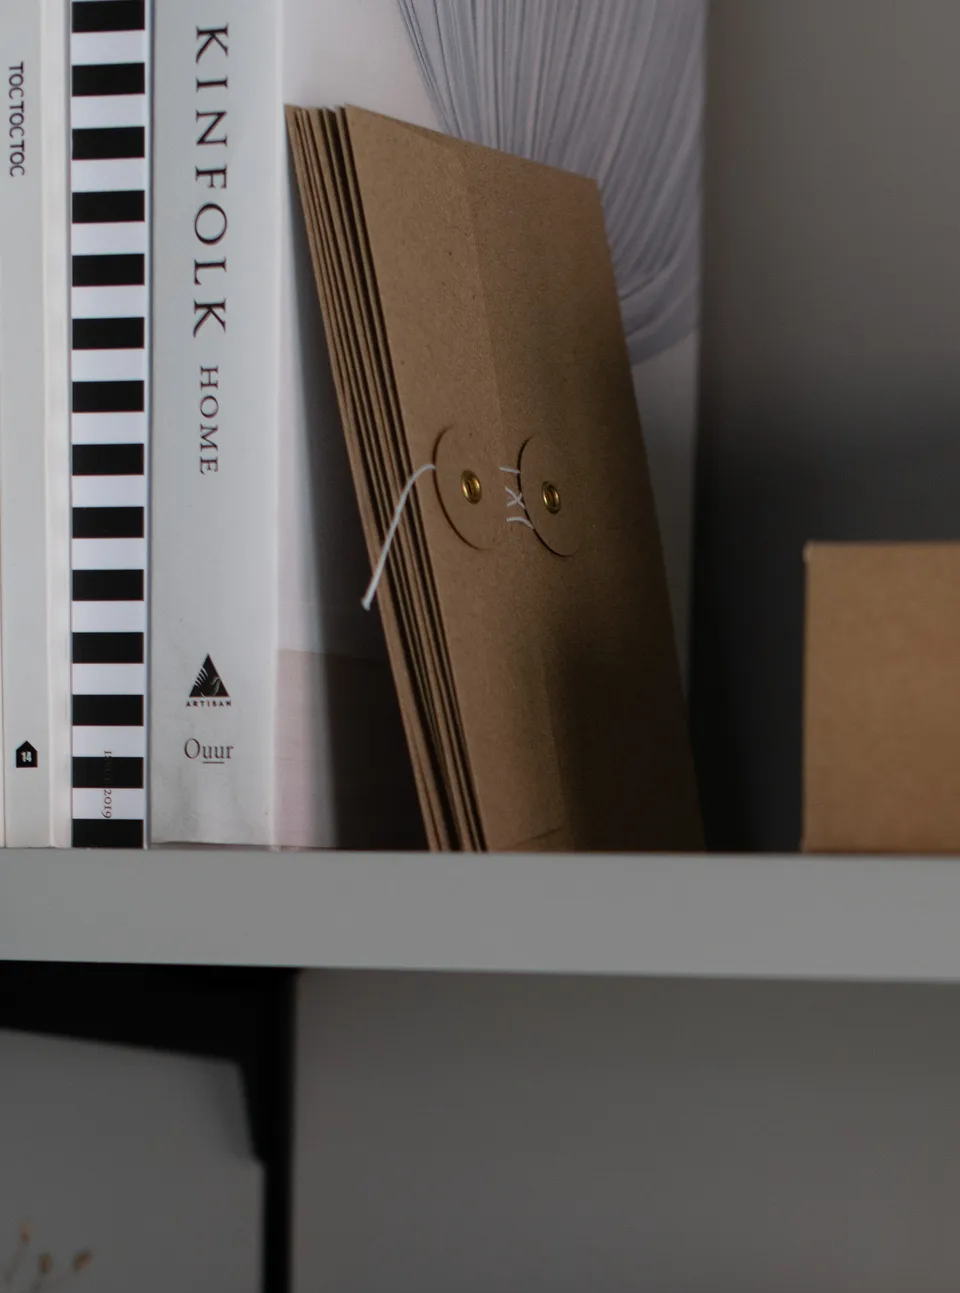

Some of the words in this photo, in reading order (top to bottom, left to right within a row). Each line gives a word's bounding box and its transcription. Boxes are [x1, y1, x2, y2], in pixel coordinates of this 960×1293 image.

[193, 24, 229, 338] KINFOLK
[199, 365, 219, 475] HOME
[21, 751, 32, 763] 14
[184, 738, 234, 760] Ouur
[101, 789, 112, 819] 2019
